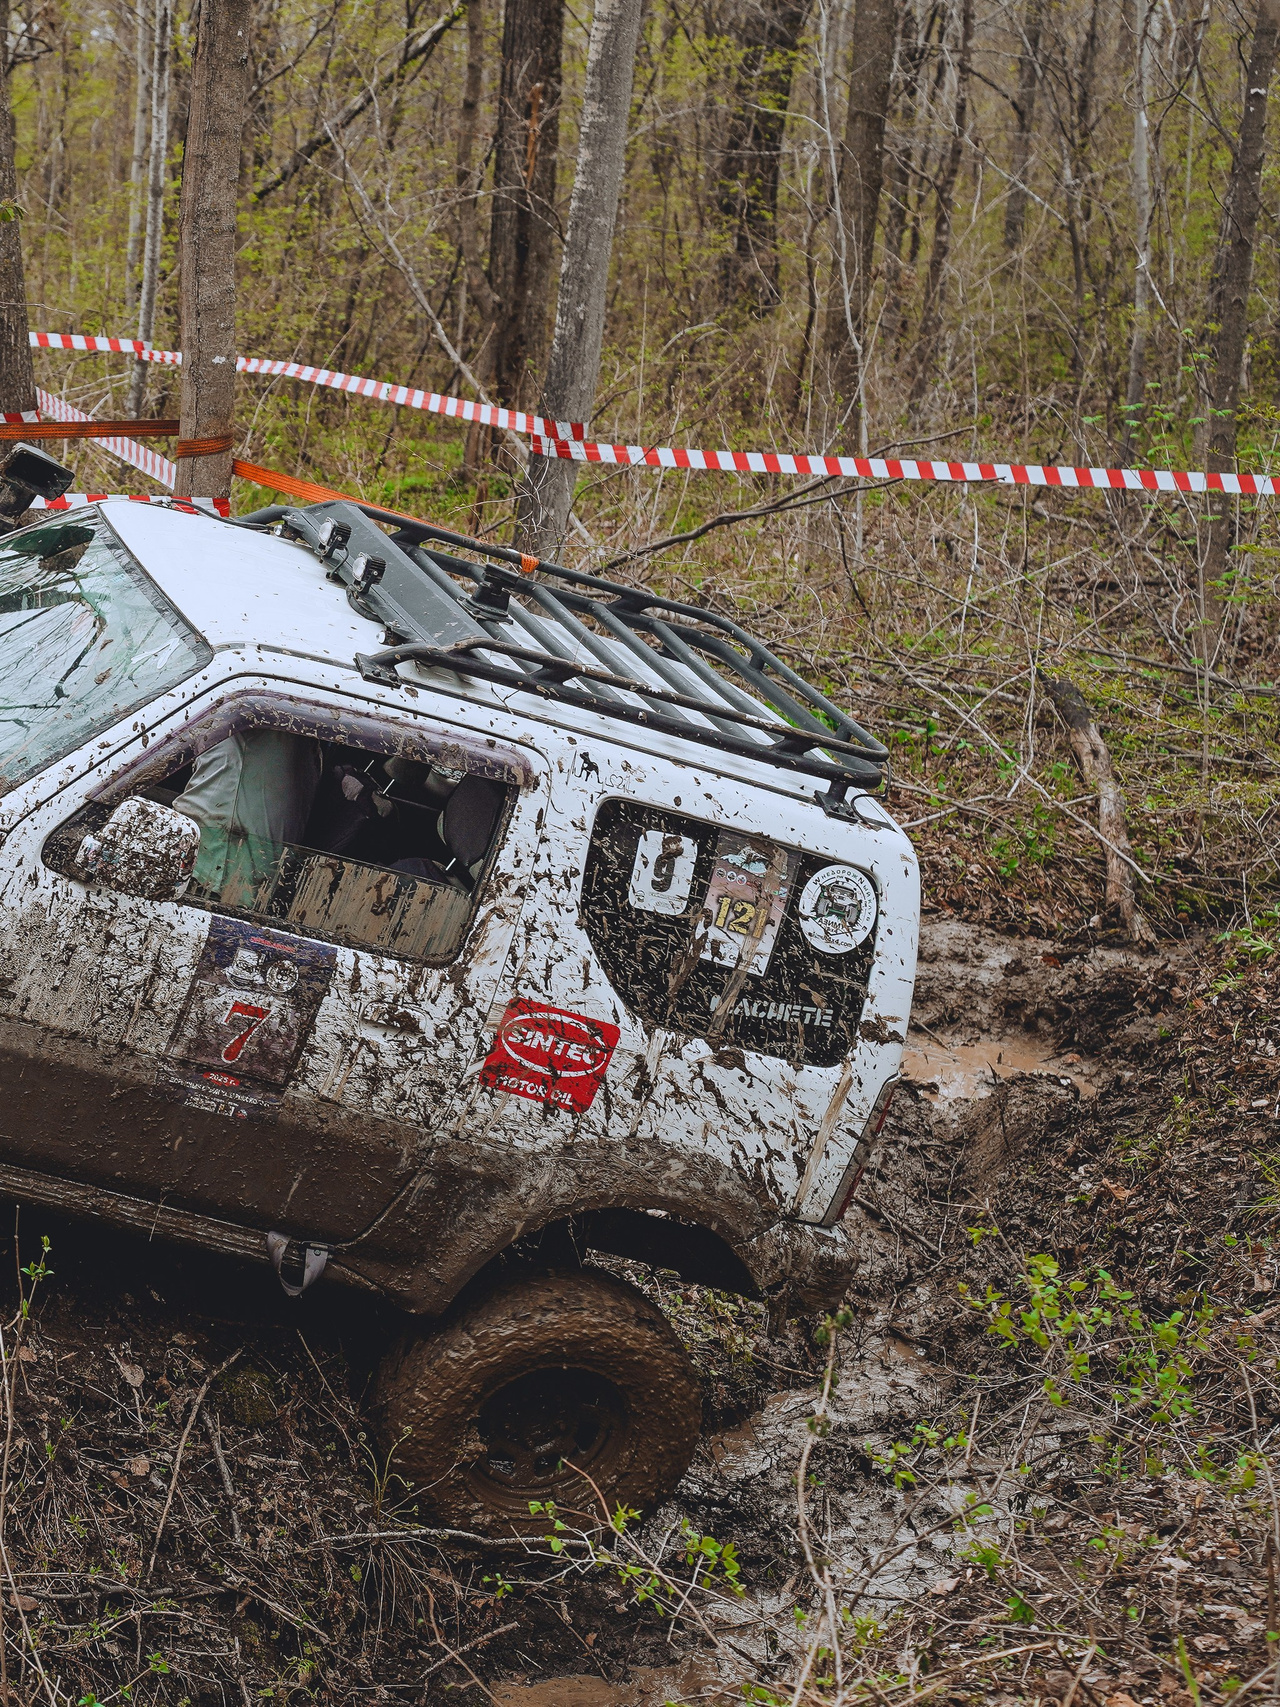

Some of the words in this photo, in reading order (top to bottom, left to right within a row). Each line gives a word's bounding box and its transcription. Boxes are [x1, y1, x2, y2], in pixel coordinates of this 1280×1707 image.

[715, 896, 768, 939] 121
[221, 1000, 273, 1064] 7
[508, 1026, 601, 1065] SINTEC
[496, 1075, 548, 1098] MOTOR
[550, 1089, 574, 1106] OIL
